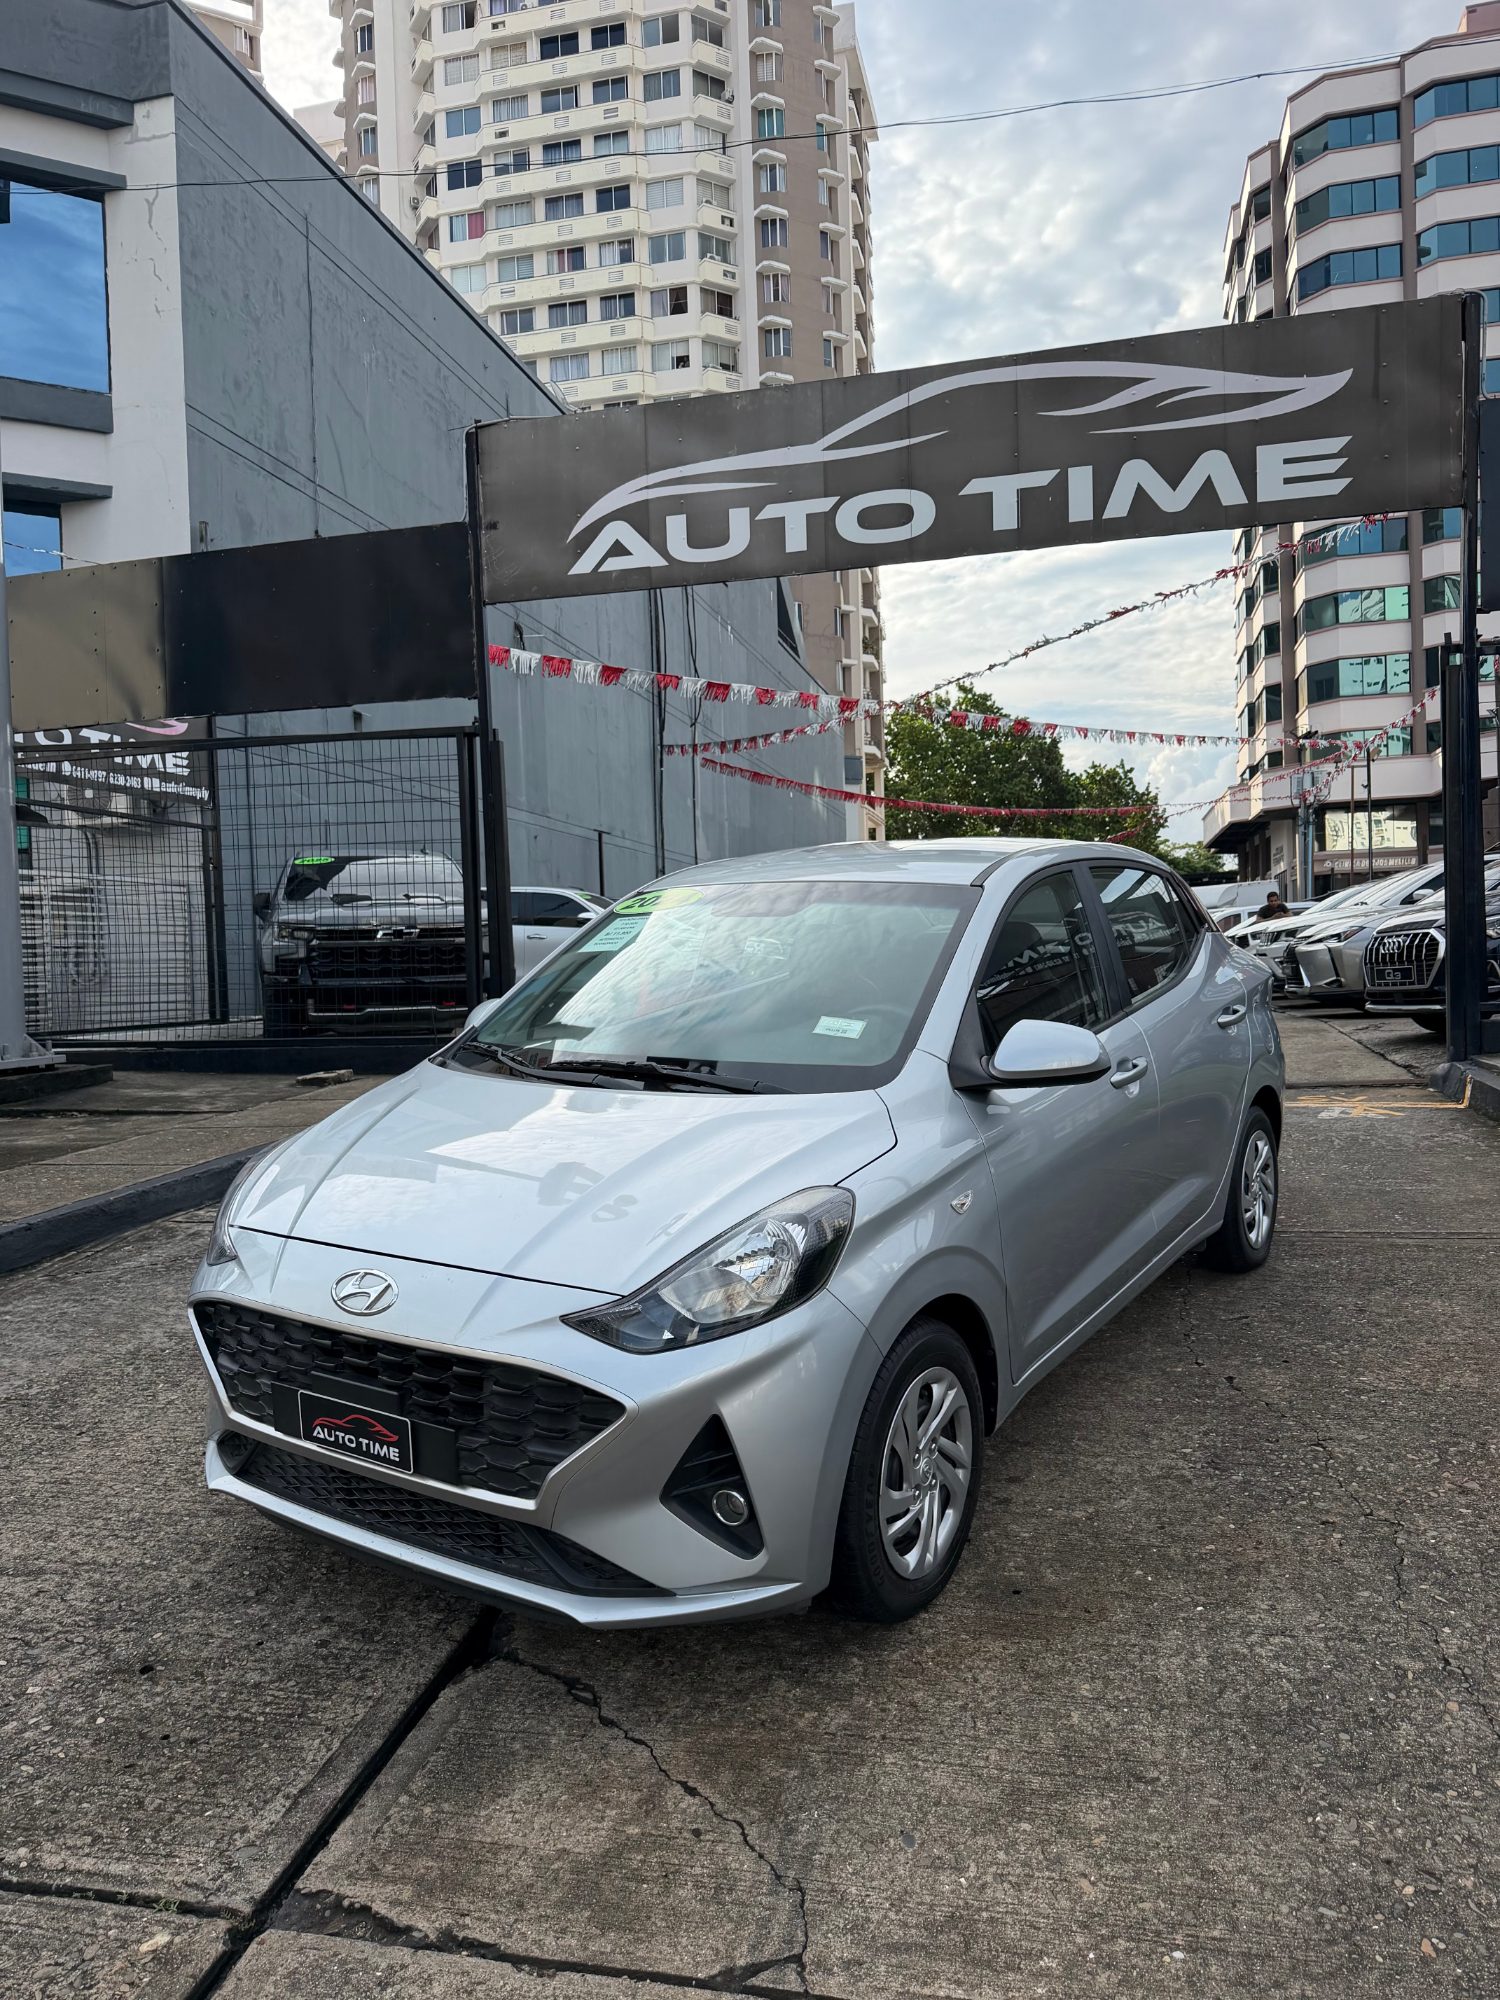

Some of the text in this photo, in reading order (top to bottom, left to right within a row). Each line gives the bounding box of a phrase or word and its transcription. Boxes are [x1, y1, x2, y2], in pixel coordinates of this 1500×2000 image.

[567, 435, 1353, 575] AUTO TIME
[1385, 969, 1402, 981] Q3
[312, 1425, 400, 1462] AUTO TIME
